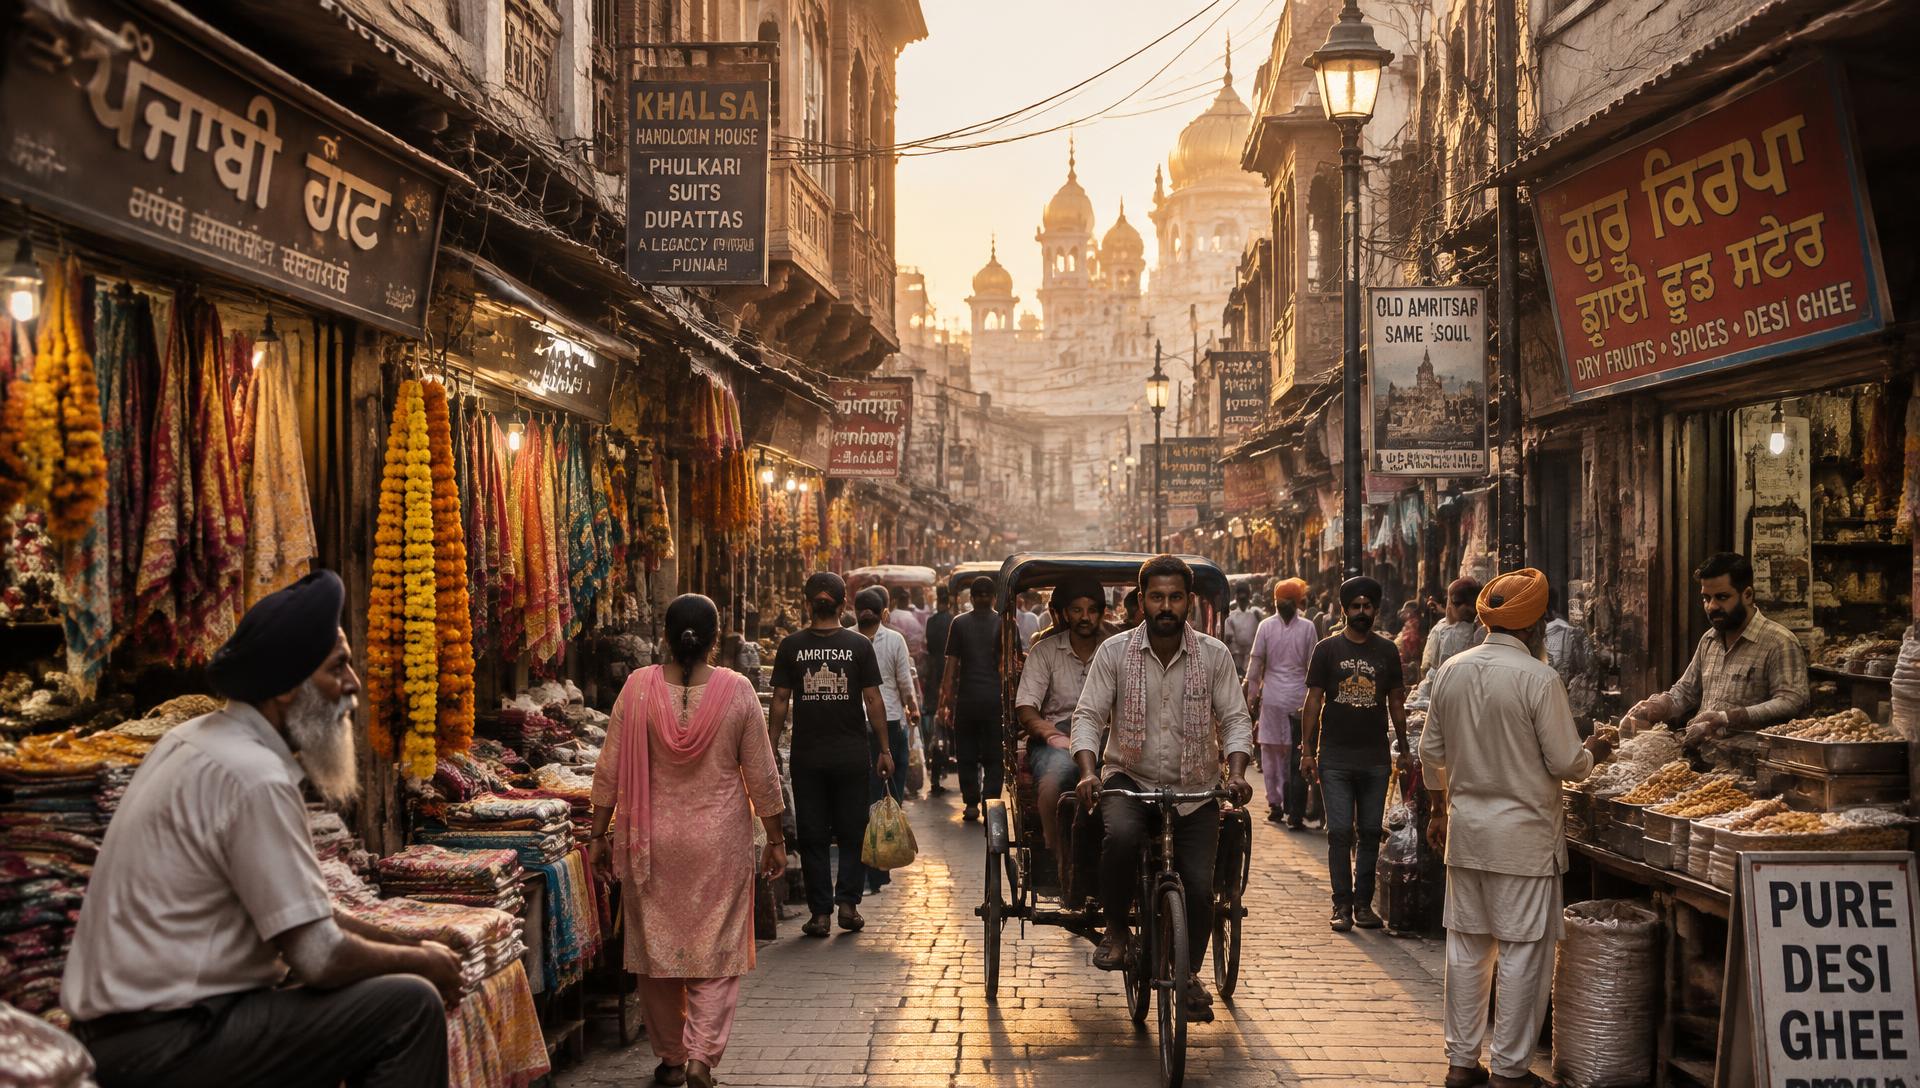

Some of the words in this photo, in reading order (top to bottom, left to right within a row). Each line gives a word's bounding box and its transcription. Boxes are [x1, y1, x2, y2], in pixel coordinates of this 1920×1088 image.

[636, 90, 760, 121] KHALSA
[714, 128, 759, 146] HOUSE
[649, 158, 741, 176] PHULKARI
[669, 183, 721, 201] SUITS
[645, 210, 743, 229] DUPATTAS
[1376, 296, 1403, 317] OLD
[1408, 297, 1478, 317] AMRITSAR
[1385, 325, 1424, 343] SAME
[1576, 354, 1601, 381] DRY
[1605, 339, 1656, 374] FRUITS
[1671, 318, 1729, 357] SPICES
[1797, 281, 1857, 322] GHEE
[796, 648, 853, 662] AMRITSAR
[1769, 880, 1897, 929] PURE
[1782, 944, 1892, 994] DESI
[1779, 1009, 1908, 1061] GHEE
